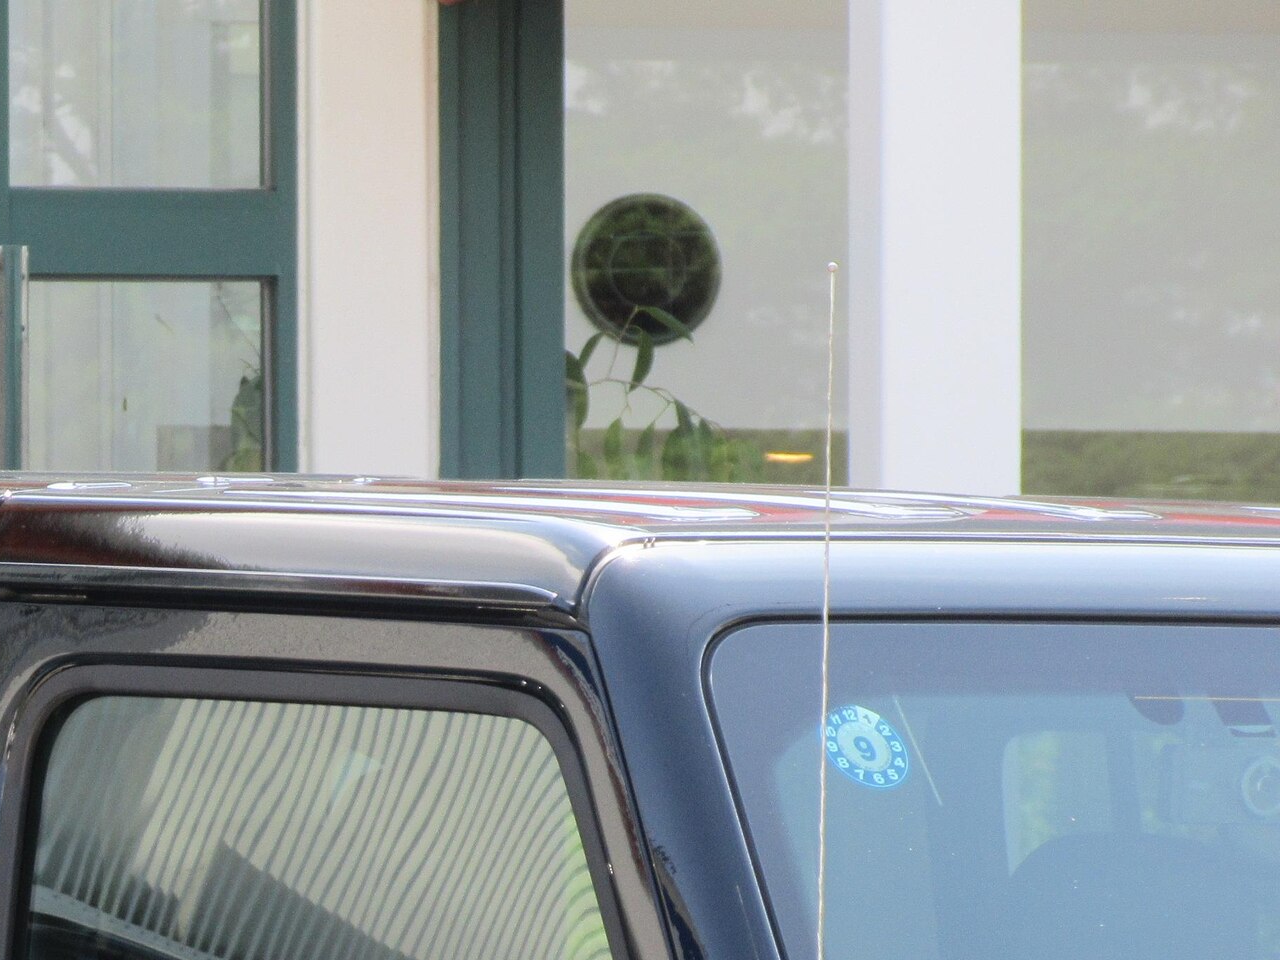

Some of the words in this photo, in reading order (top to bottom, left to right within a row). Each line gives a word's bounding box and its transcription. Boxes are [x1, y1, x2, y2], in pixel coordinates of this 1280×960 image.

[842, 709, 858, 721] 12
[880, 725, 892, 736] 2
[826, 741, 838, 752] 9
[853, 736, 877, 761] 9
[890, 741, 902, 752] 3
[837, 757, 849, 768] 8
[894, 757, 905, 768] 4
[854, 769, 865, 780] 7
[873, 773, 885, 784] 6
[887, 769, 899, 780] 5
